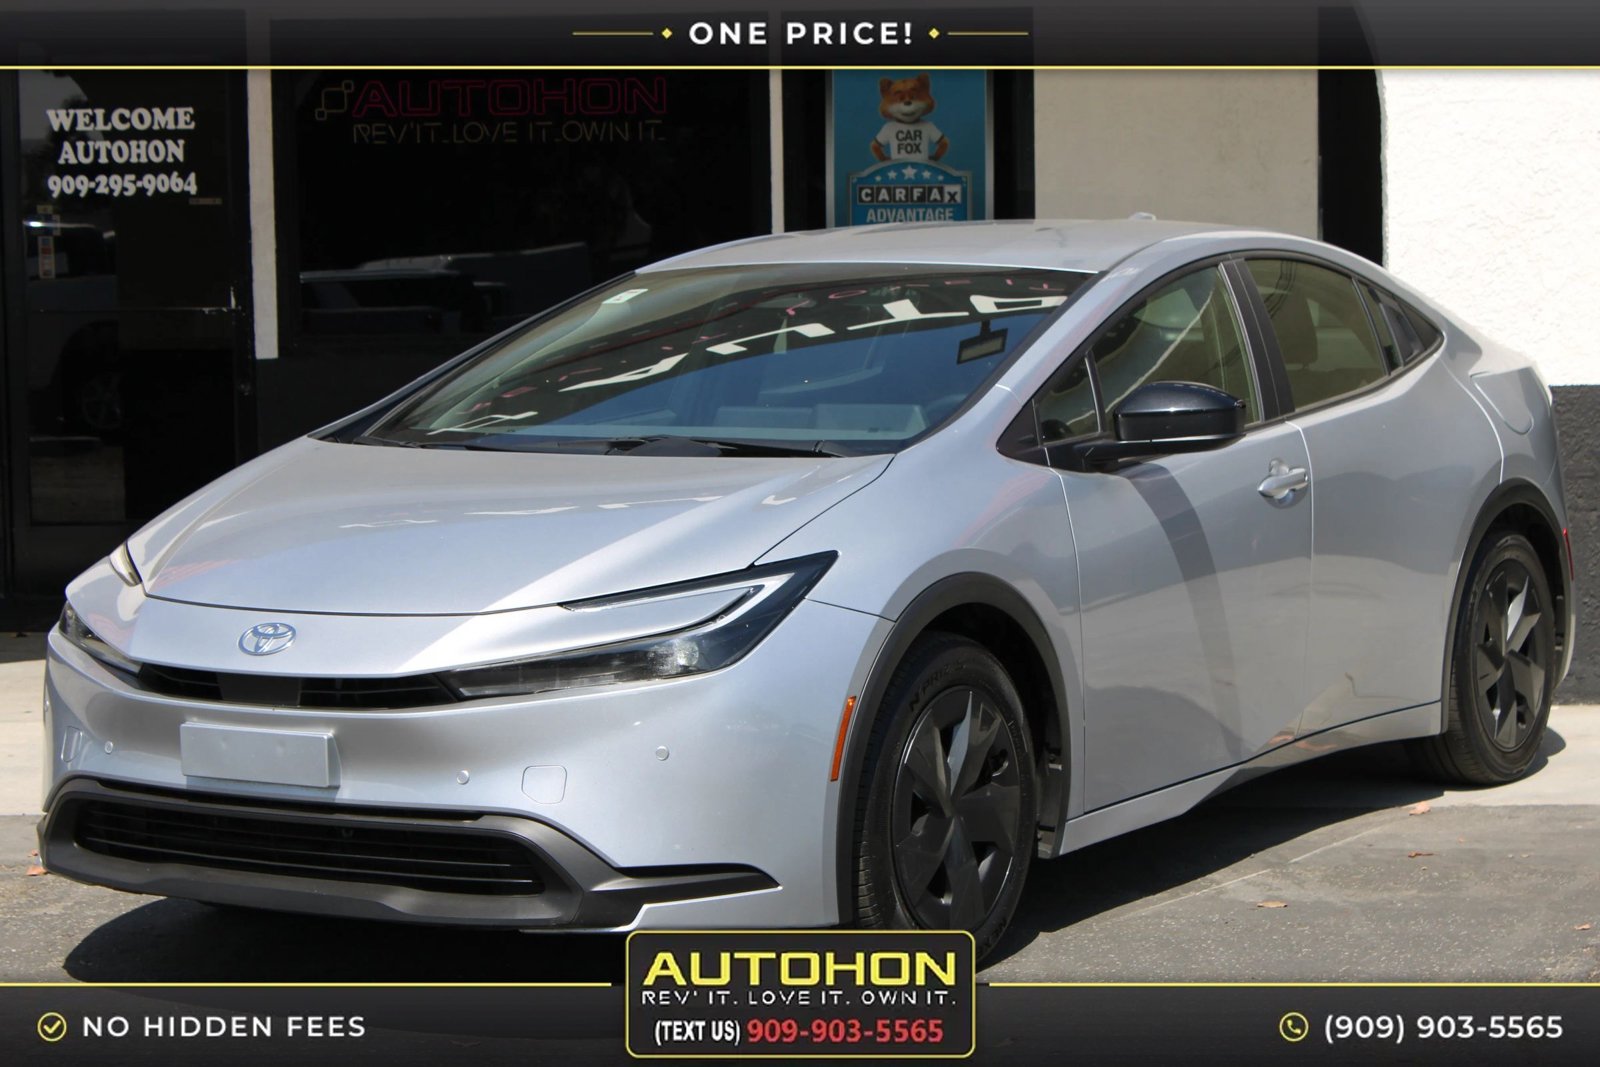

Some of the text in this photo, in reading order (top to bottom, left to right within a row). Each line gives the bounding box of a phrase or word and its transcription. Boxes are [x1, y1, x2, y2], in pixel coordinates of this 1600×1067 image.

[351, 77, 667, 118] AUTOHON
[46, 107, 196, 132] WELCOME
[895, 129, 923, 142] CAR
[57, 139, 185, 165] AUTOHON
[897, 142, 923, 155] FOX
[47, 171, 198, 199] 909-295-9064
[859, 187, 961, 204] CARFAX
[866, 207, 954, 223] ADVANTAGE
